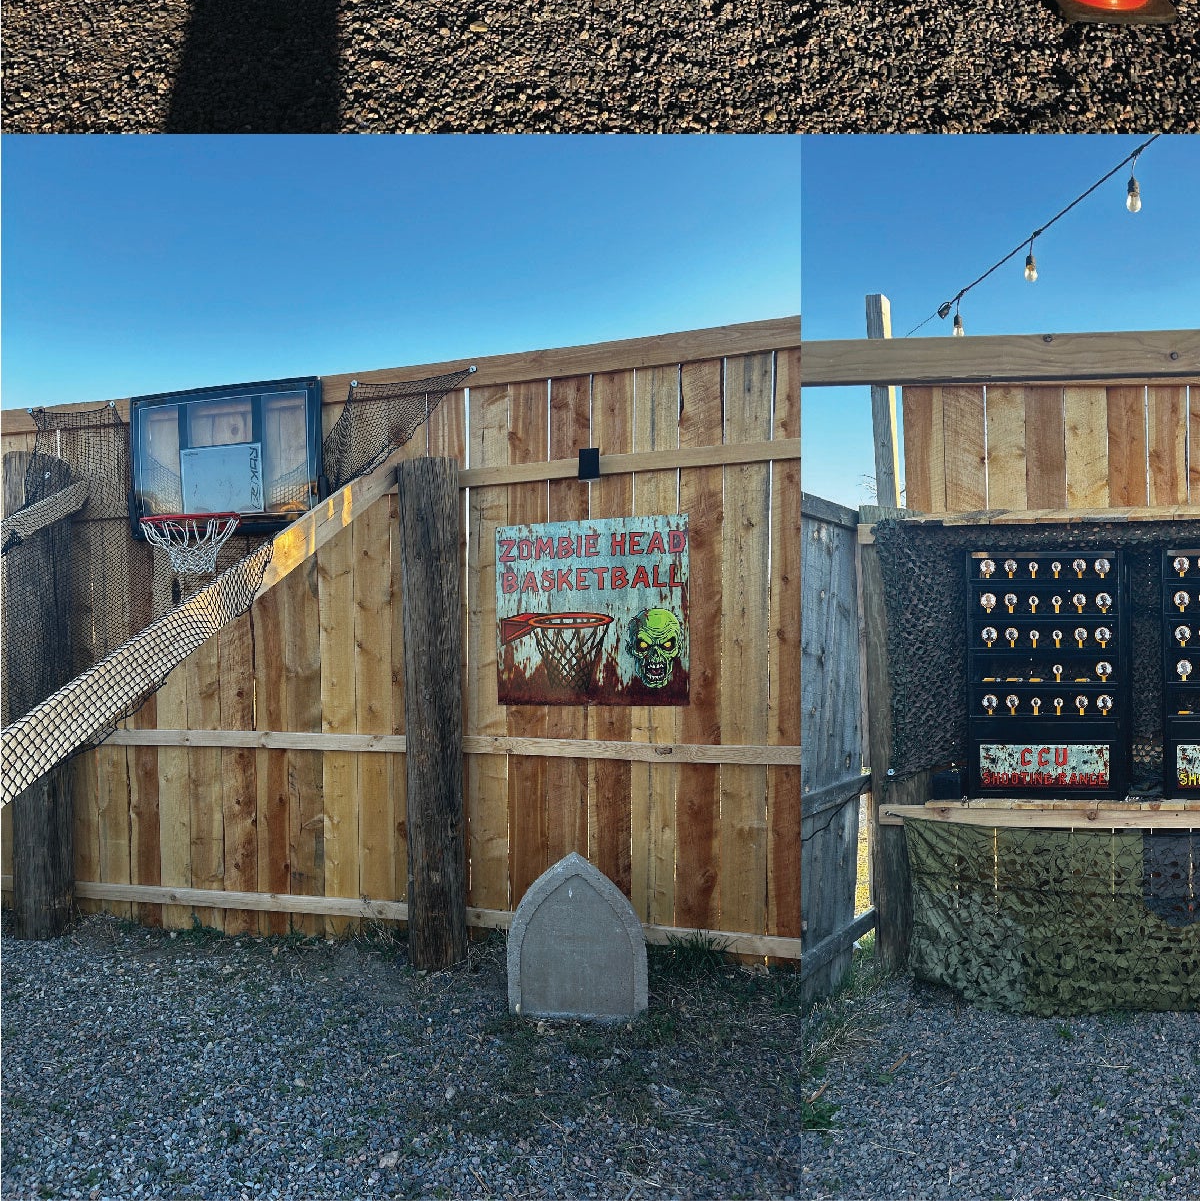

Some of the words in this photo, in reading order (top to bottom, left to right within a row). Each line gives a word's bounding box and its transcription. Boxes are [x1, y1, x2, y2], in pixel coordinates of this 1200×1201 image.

[498, 534, 600, 562] ZOMBIE
[610, 530, 687, 557] HEAD
[502, 564, 686, 594] BASKETBALL
[1020, 747, 1069, 767] CCU
[982, 771, 1053, 785] SHOOTING
[1058, 771, 1107, 785] RANGE
